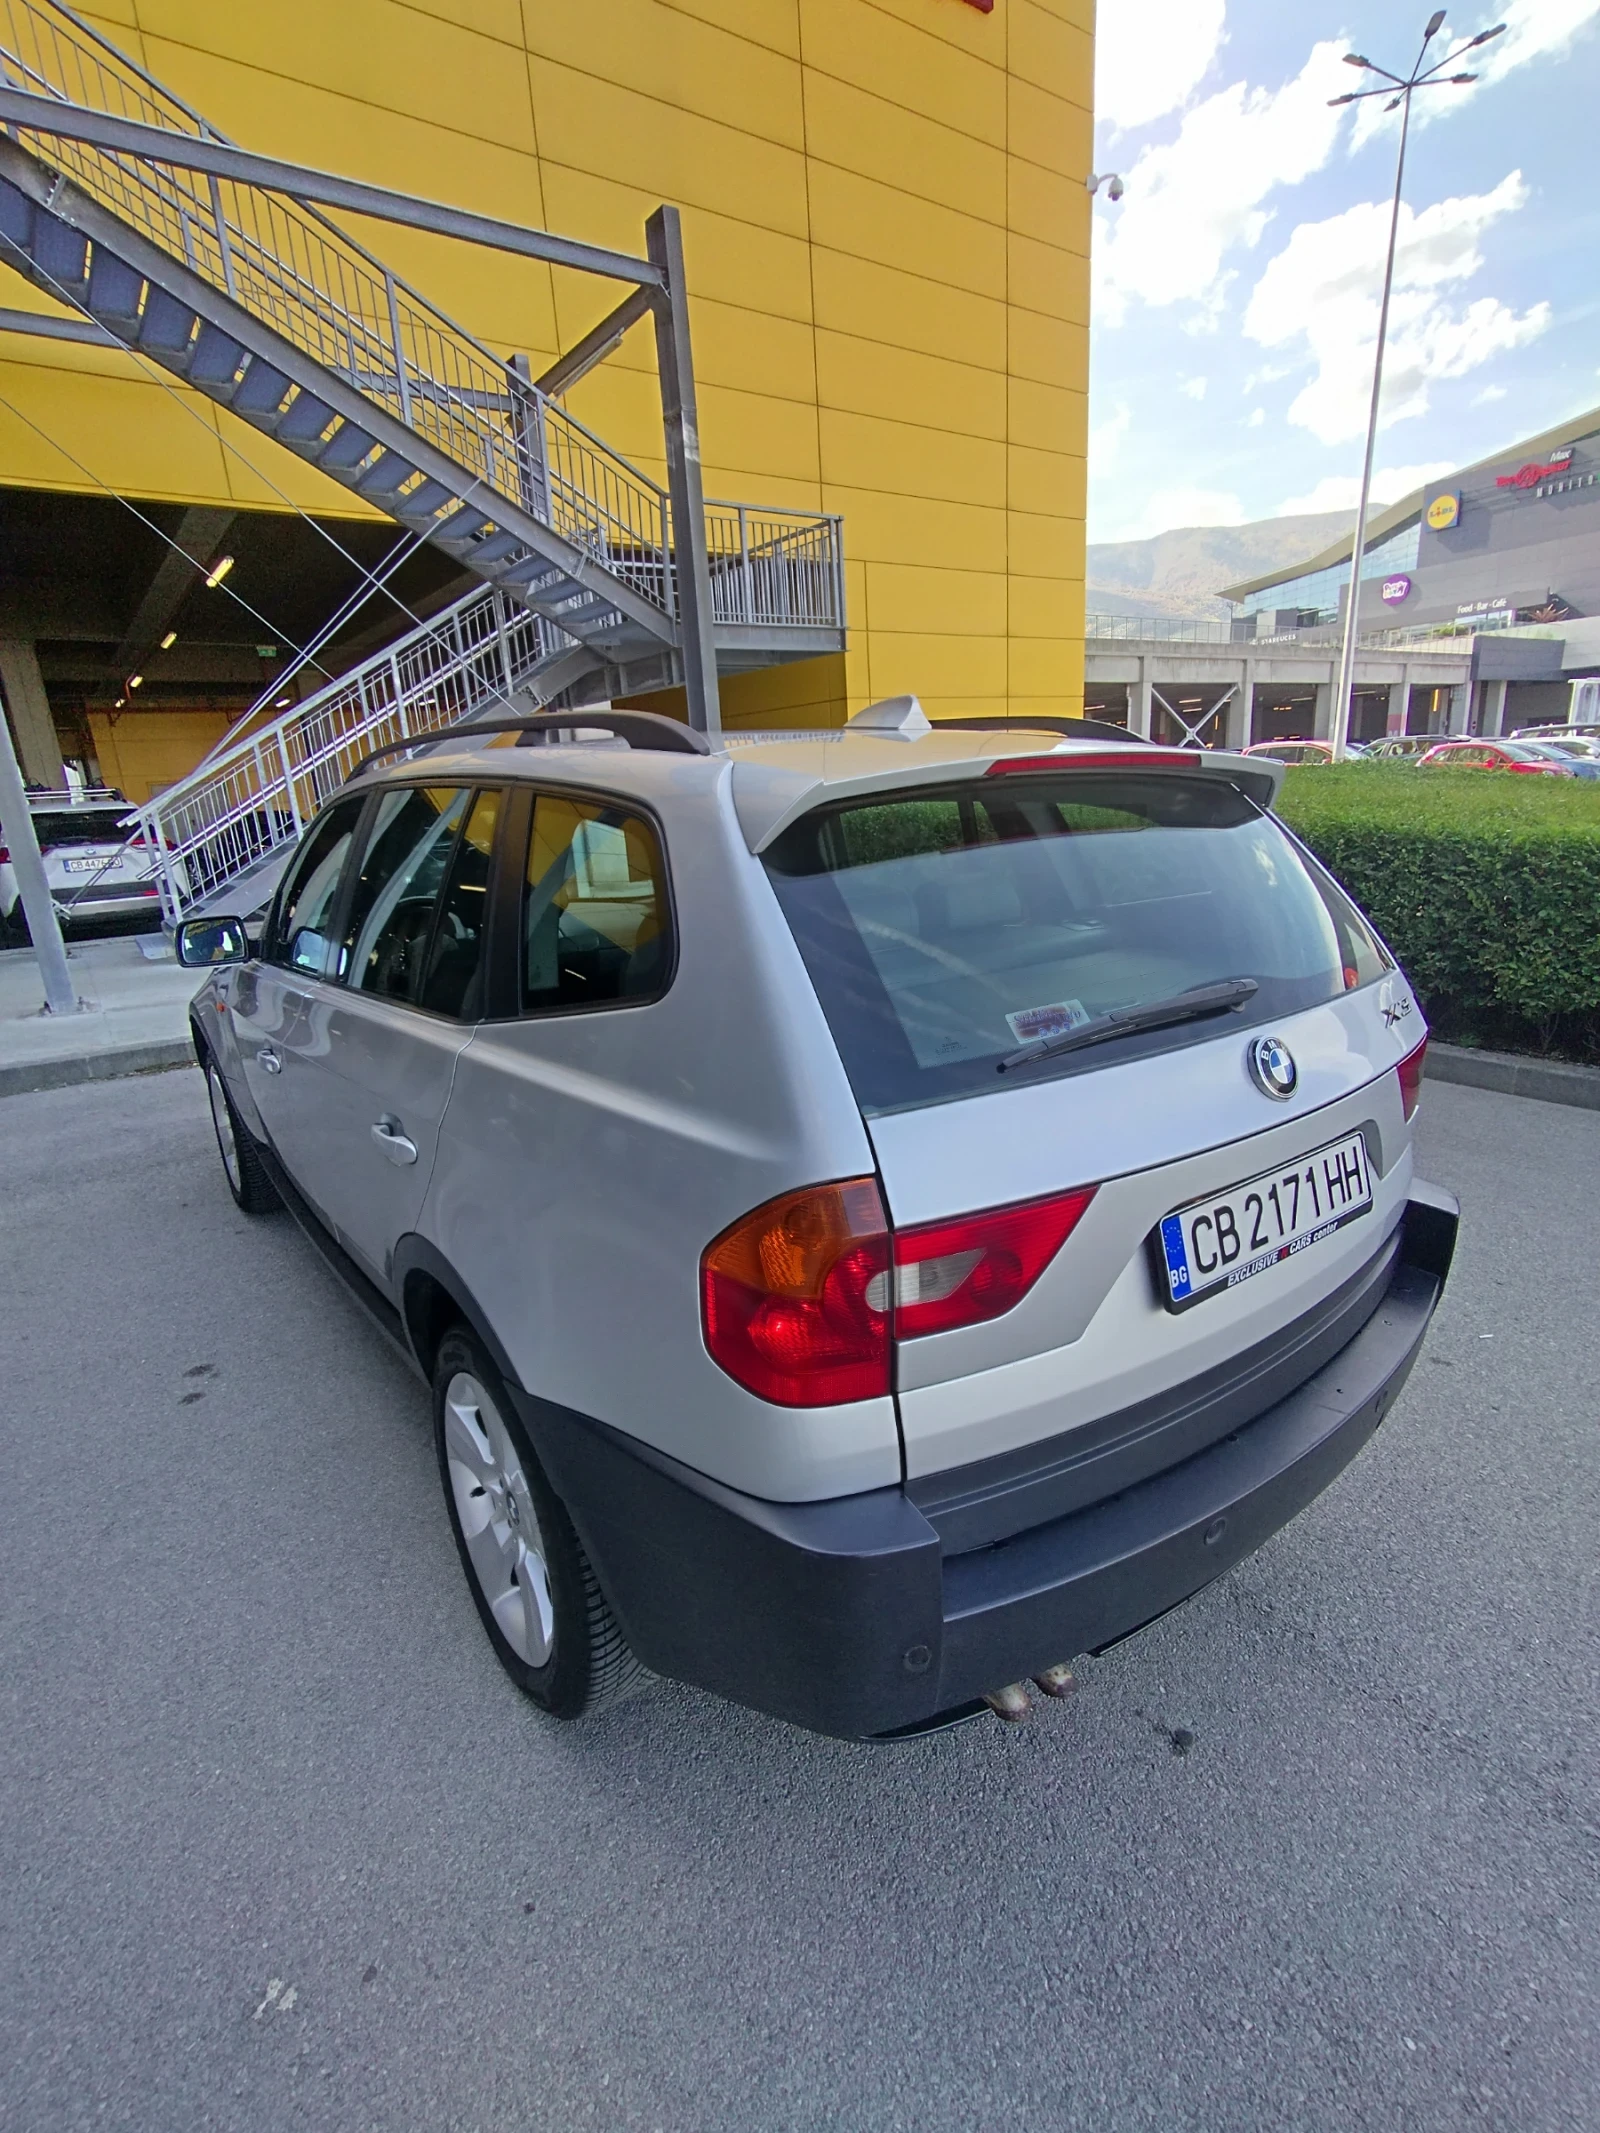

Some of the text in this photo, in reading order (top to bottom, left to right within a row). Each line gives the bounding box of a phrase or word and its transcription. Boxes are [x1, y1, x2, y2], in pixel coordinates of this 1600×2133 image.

[1536, 475, 1594, 498] MOHITO
[1457, 603, 1474, 614] Food
[1476, 601, 1489, 611] Bar
[1380, 996, 1413, 1029] X3
[1191, 1146, 1364, 1275] CB 2171 HH
[1227, 1221, 1339, 1287] EXCLUSIVE CARS center
[1170, 1265, 1188, 1288] BG
